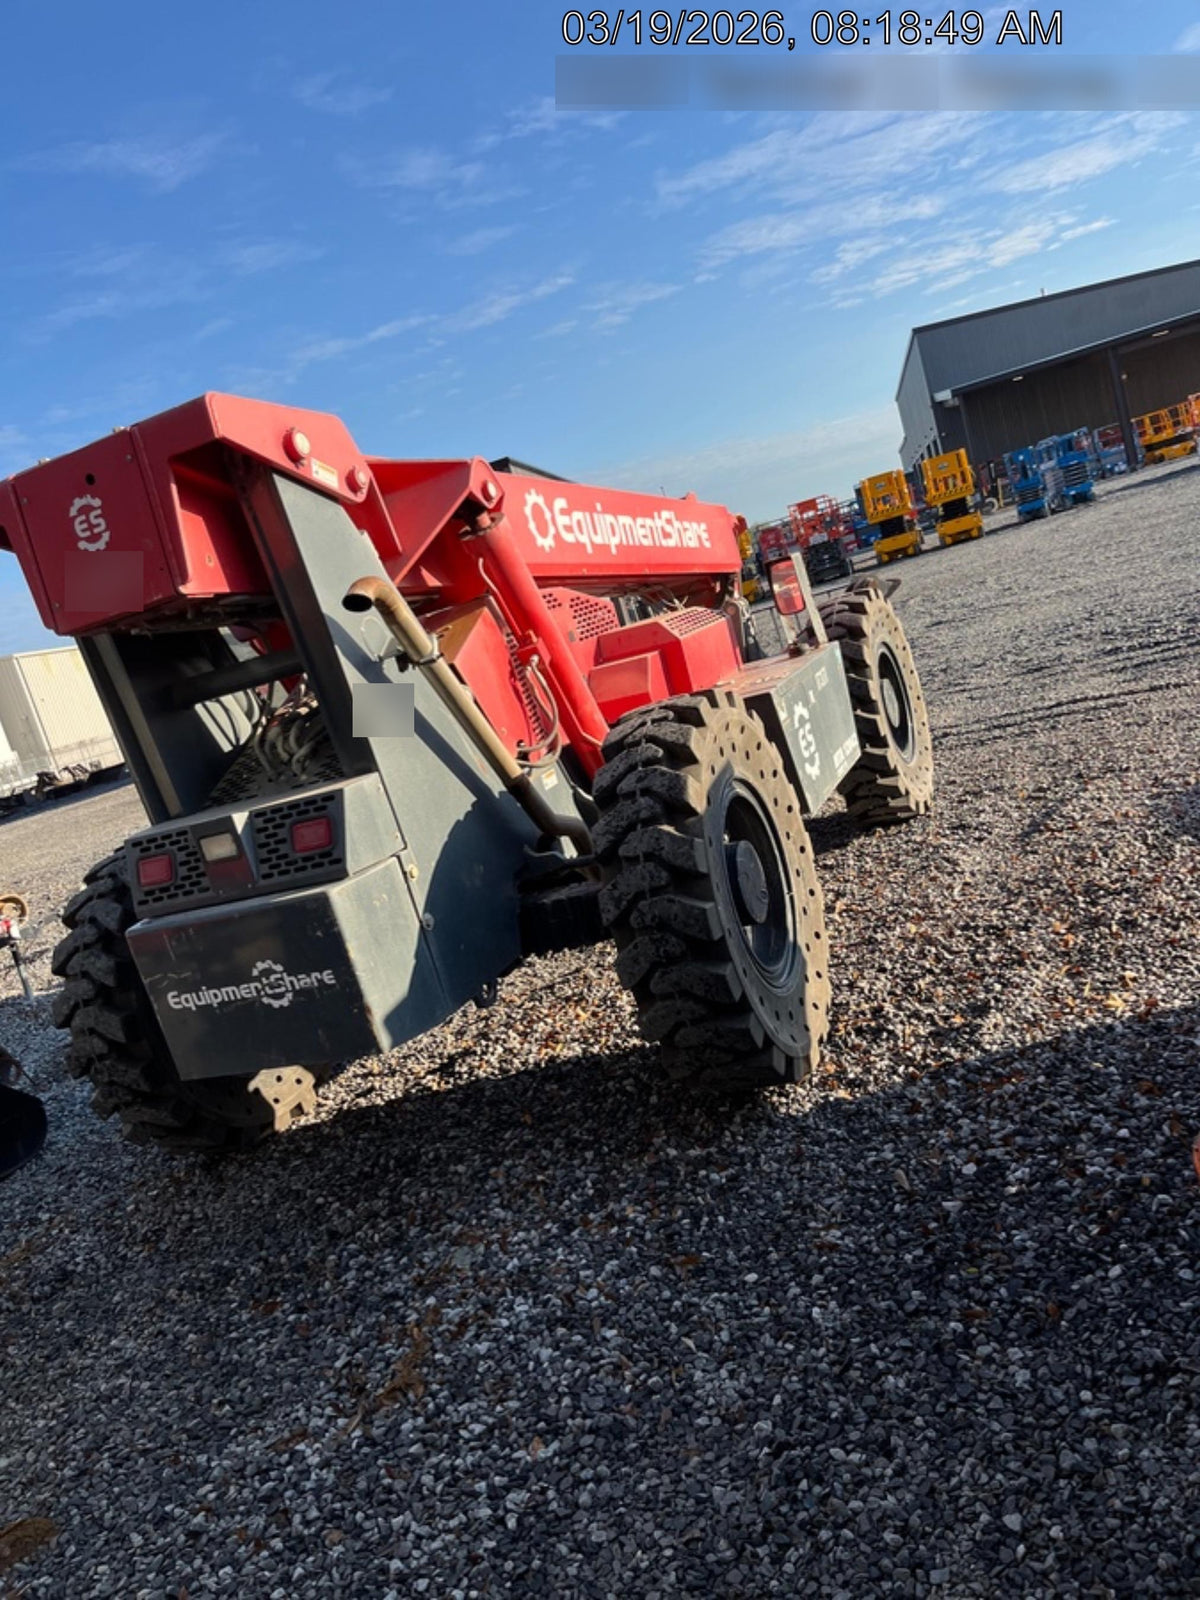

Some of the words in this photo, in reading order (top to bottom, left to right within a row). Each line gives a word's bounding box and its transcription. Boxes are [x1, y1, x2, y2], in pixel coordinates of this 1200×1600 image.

[74, 508, 107, 538] ES
[553, 497, 712, 555] EquipmentShare
[167, 969, 337, 1011] EquipmentShare
